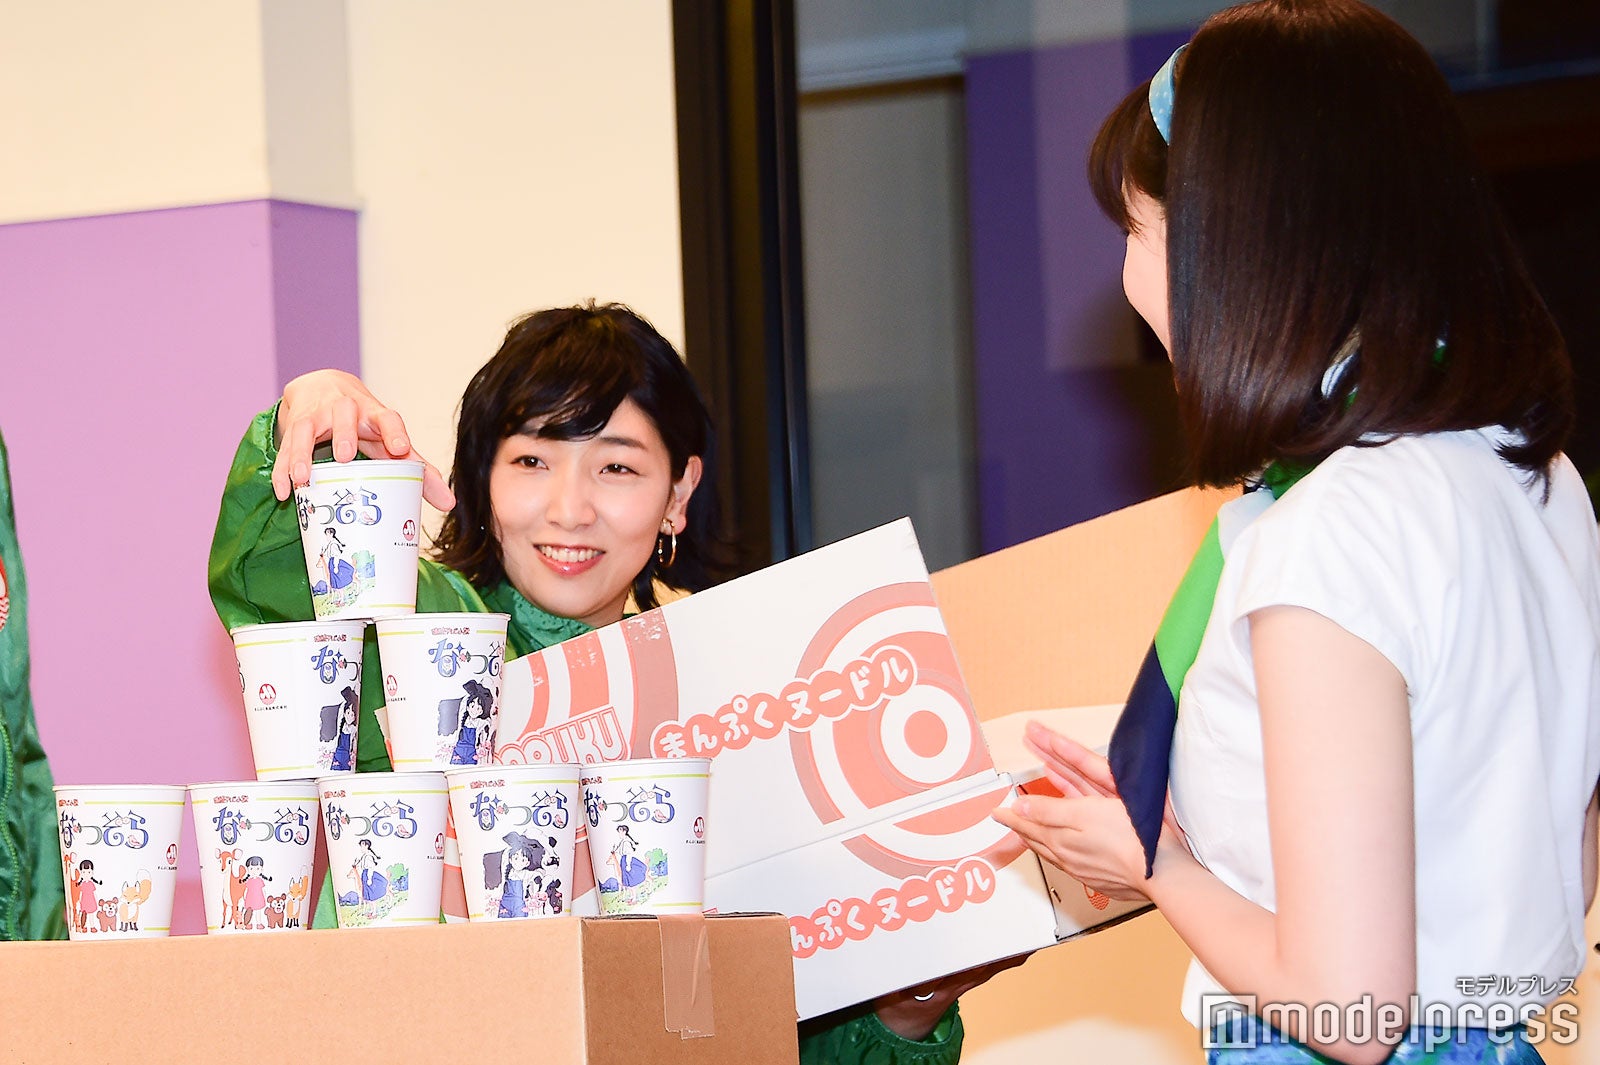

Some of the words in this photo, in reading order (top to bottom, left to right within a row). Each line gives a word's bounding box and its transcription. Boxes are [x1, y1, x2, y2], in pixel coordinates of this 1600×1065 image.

[428, 638, 505, 677] なつぞ
[659, 656, 908, 758] まんぷくヌードル
[493, 706, 628, 764] PUKU
[212, 805, 310, 846] なつぞら
[326, 798, 418, 840] なつぞら
[469, 788, 569, 831] なつぞら
[584, 783, 675, 827] なつぞら
[60, 809, 149, 849] なつぞら
[790, 867, 991, 952] んぷくヌードル
